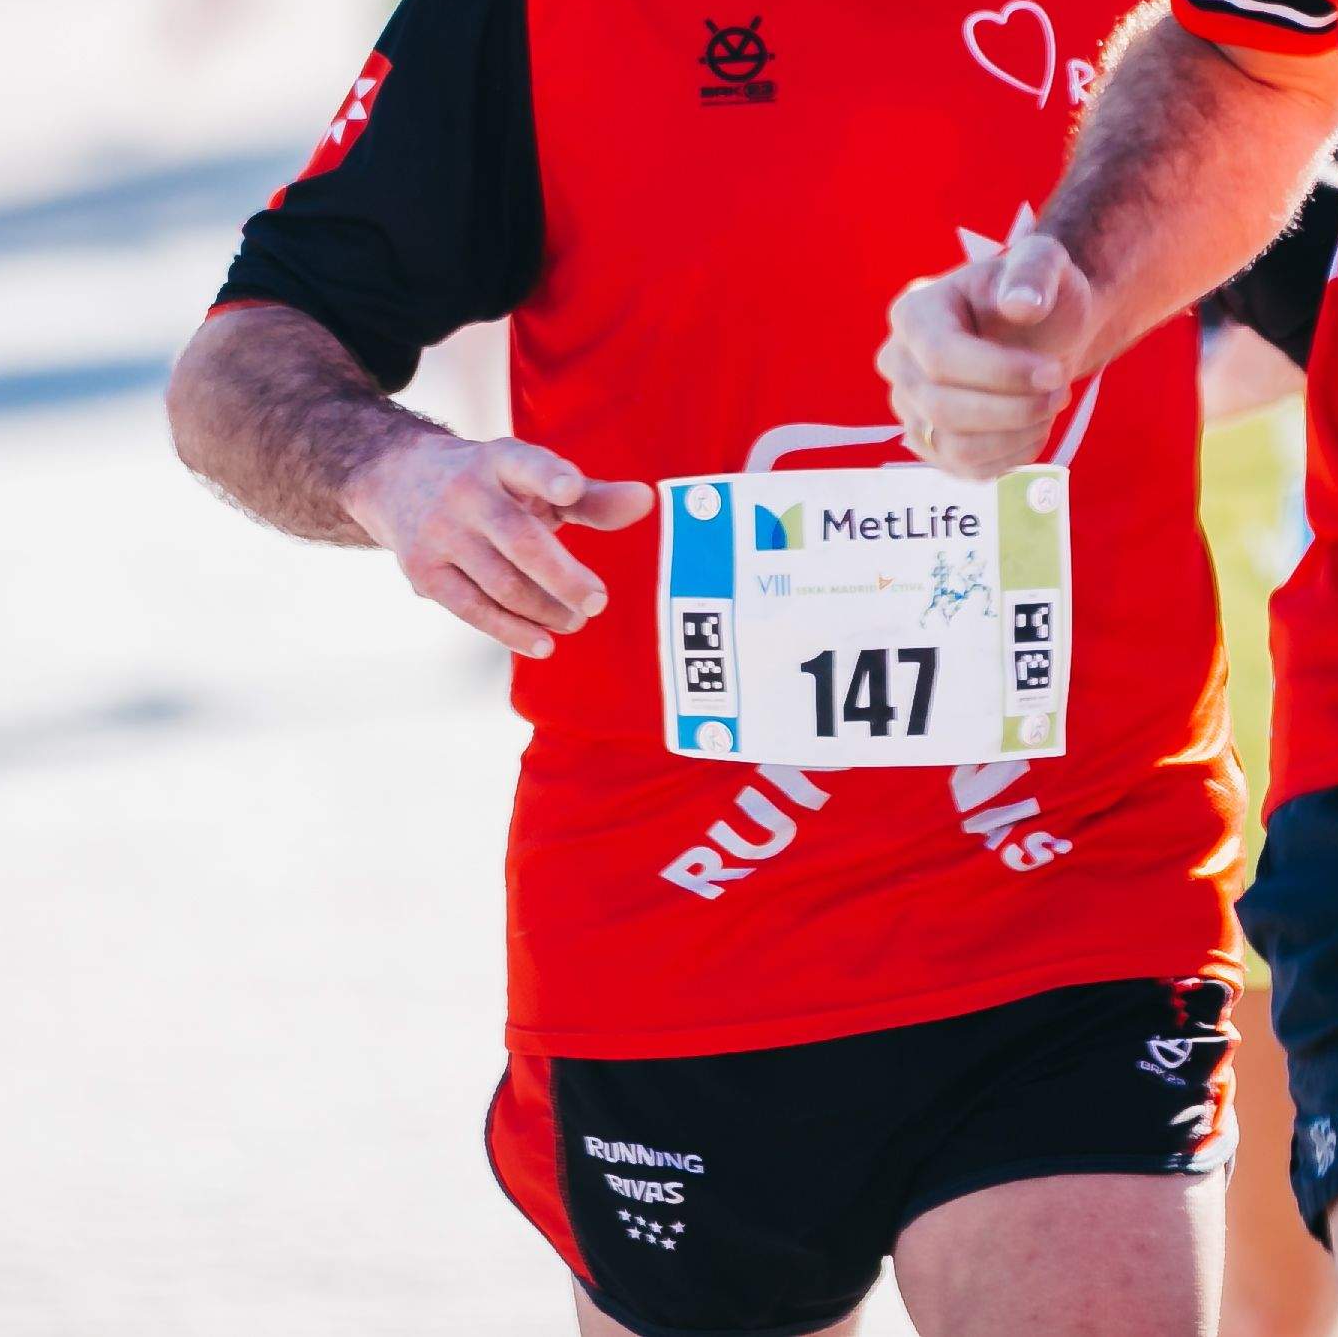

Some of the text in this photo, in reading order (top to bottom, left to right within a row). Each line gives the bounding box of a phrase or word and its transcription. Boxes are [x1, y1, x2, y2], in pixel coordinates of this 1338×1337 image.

[822, 505, 981, 541] MetLife
[757, 573, 792, 597] VIII
[800, 645, 940, 738] 147
[583, 1134, 705, 1175] RUNNING
[603, 1172, 685, 1205] RIVAS
